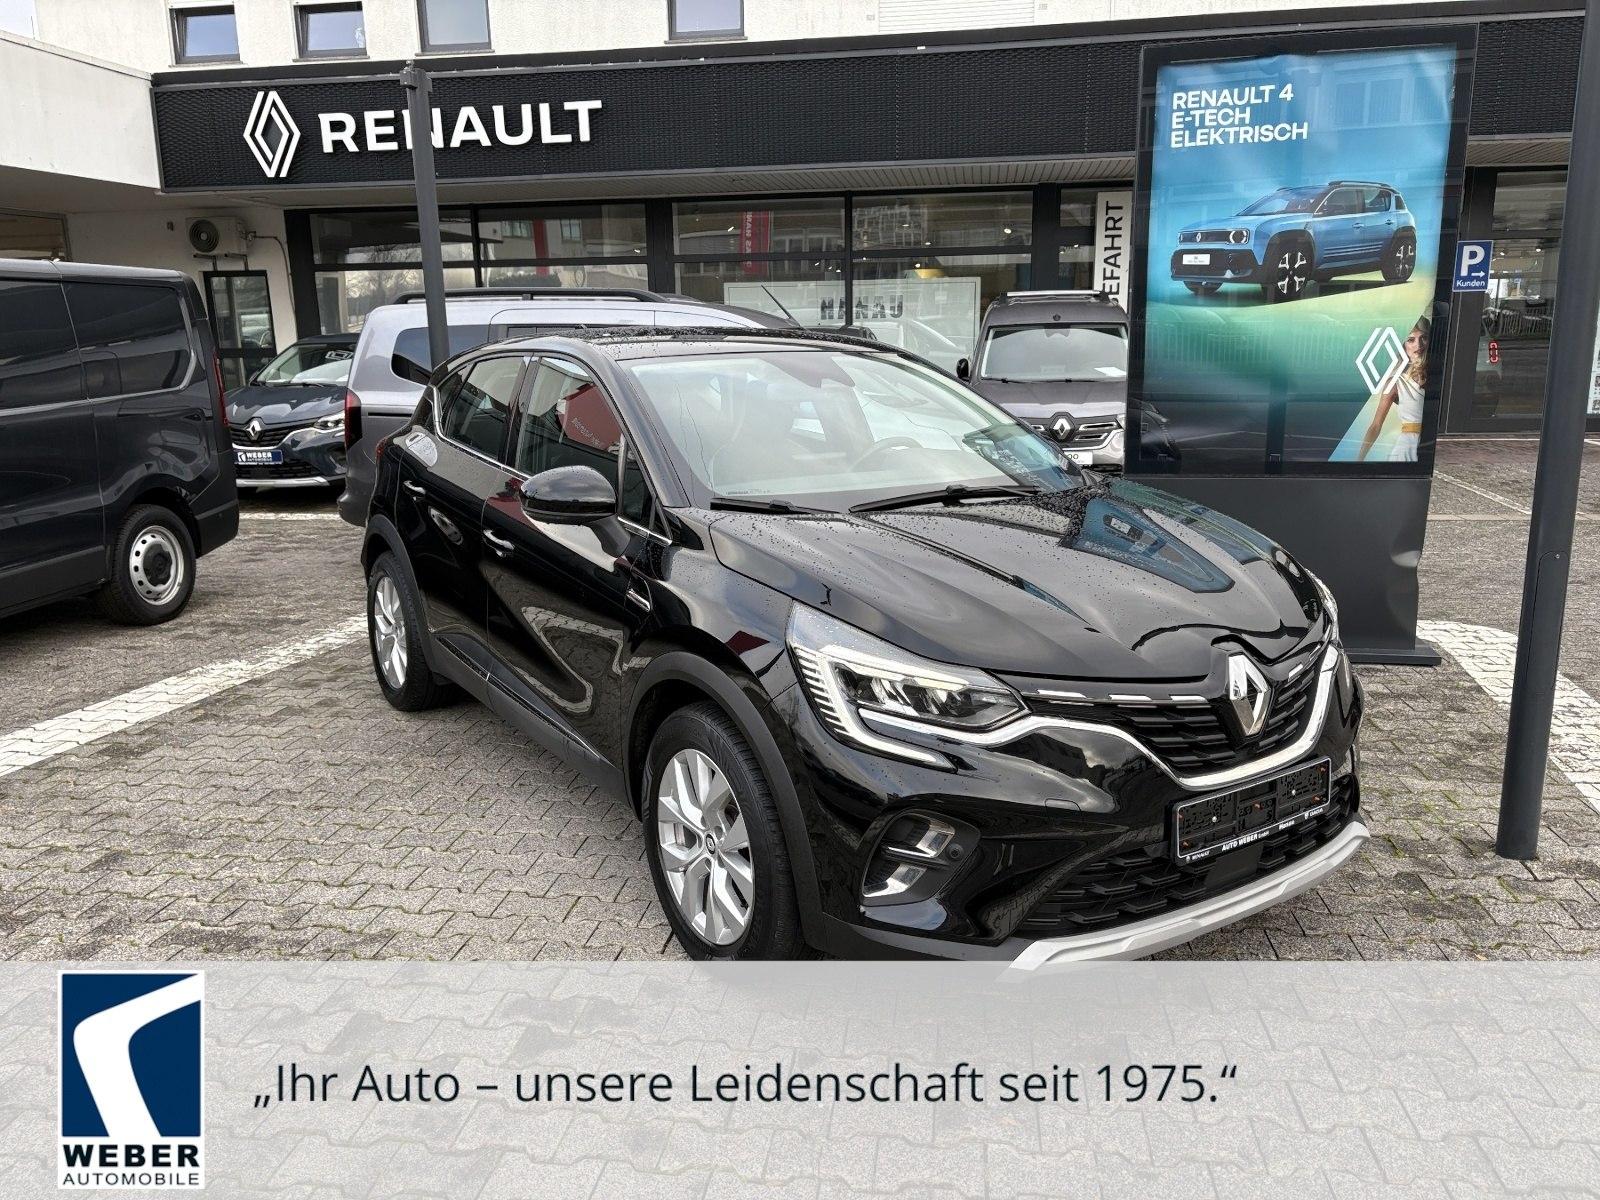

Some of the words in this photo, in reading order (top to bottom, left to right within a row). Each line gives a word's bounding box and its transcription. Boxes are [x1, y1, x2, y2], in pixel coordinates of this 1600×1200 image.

[1172, 85, 1275, 110] RENAULT
[1278, 83, 1294, 101] 4
[318, 100, 603, 153] RENAULT
[1171, 106, 1251, 129] E-TECH
[1170, 121, 1309, 148] ELEKTRISCH
[1460, 245, 1485, 276] P
[1456, 279, 1485, 287] Kunden
[1221, 841, 1238, 851] AUTO
[1238, 834, 1257, 845] WEBER
